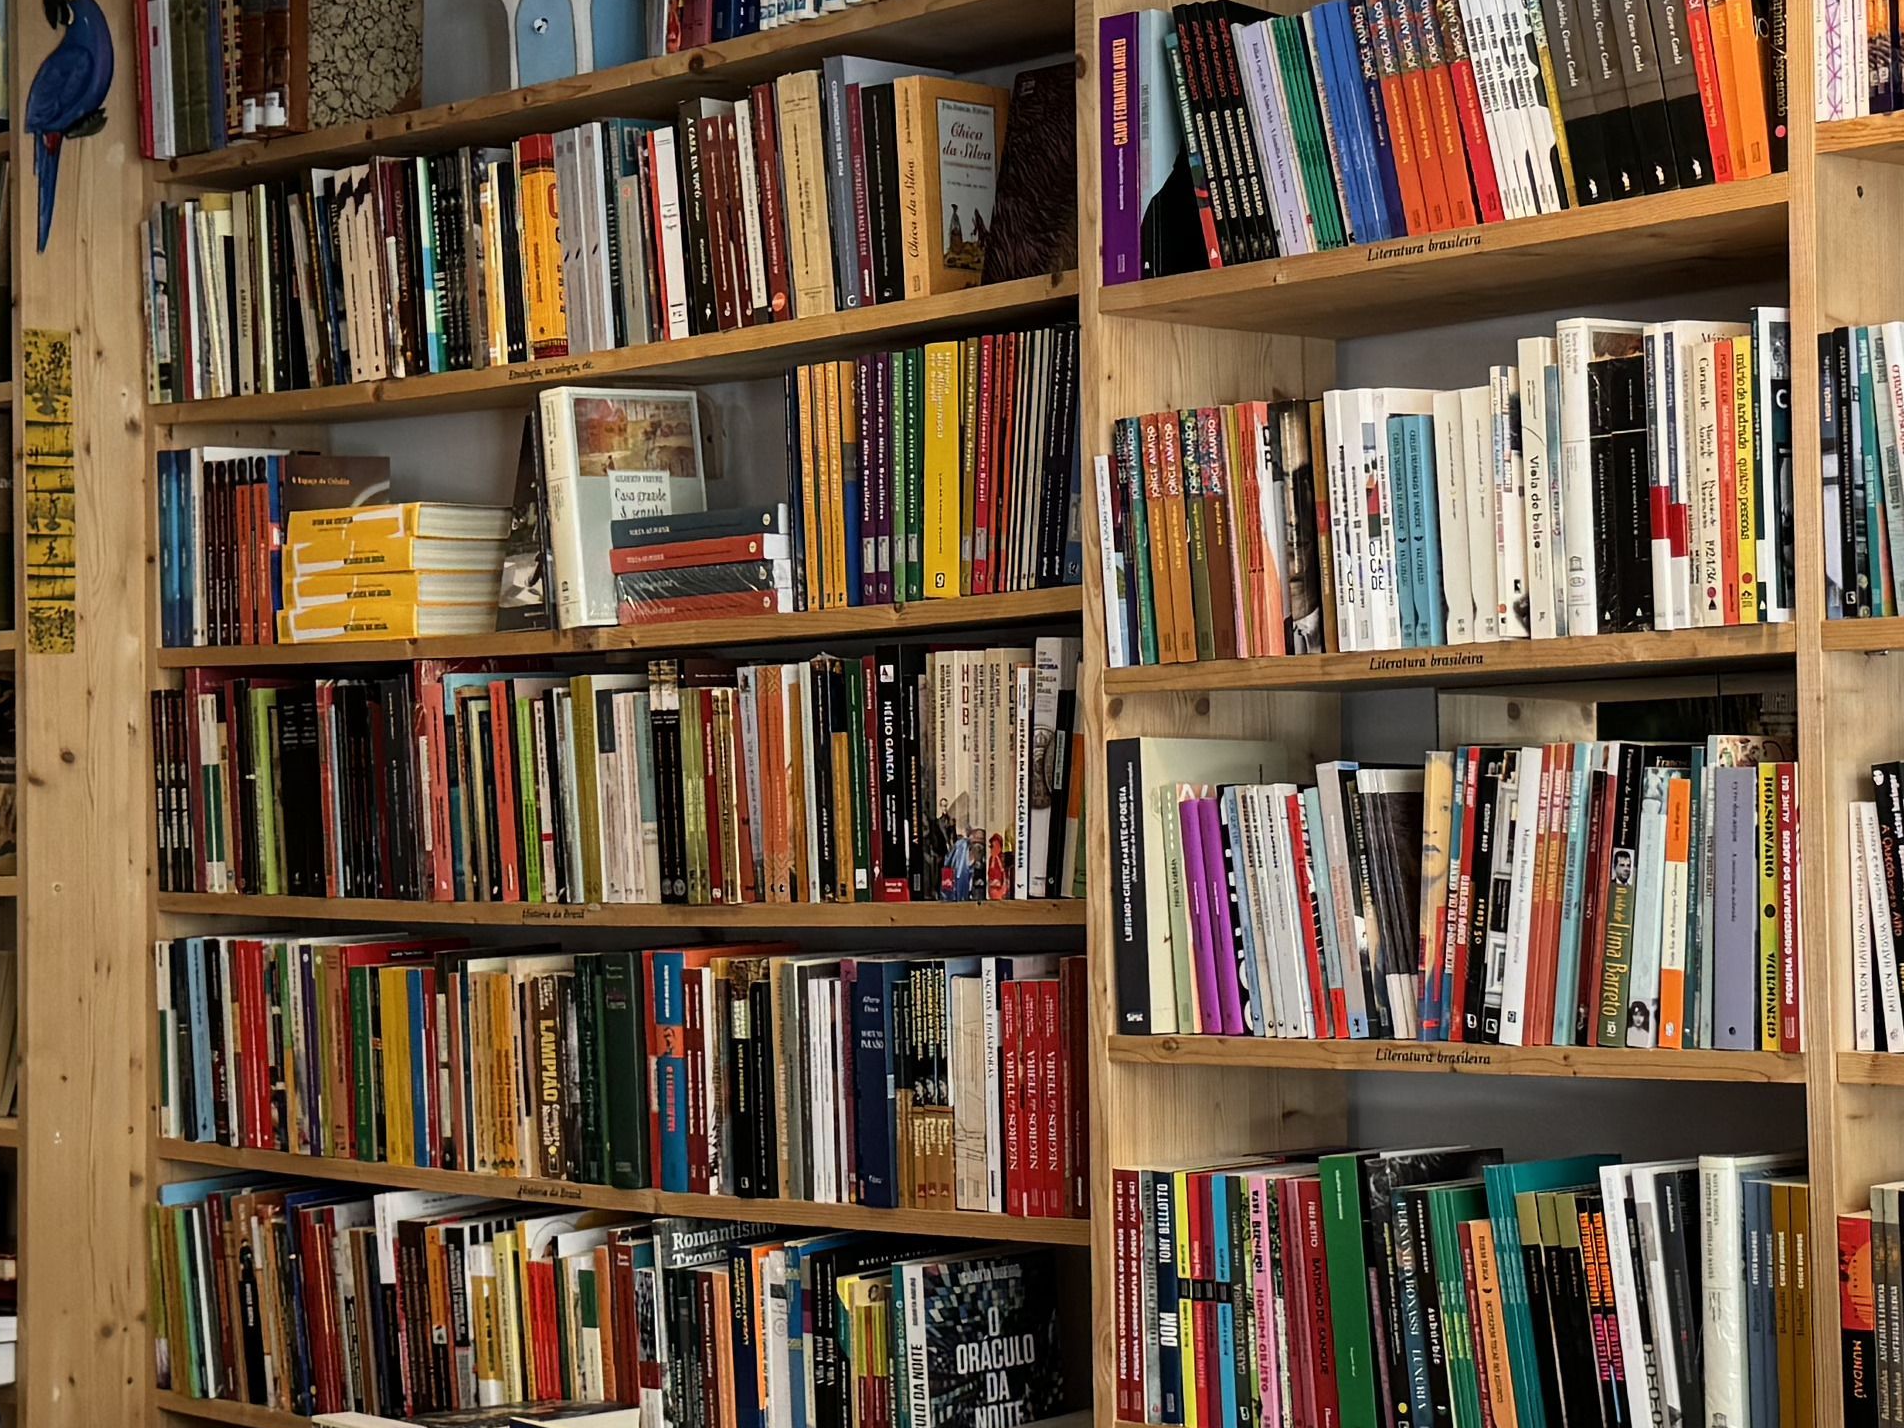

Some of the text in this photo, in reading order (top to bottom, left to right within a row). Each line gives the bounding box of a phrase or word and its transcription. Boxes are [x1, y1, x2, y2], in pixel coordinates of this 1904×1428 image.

[951, 122, 983, 141] Chica
[943, 140, 991, 161] da Silva
[1367, 233, 1482, 263] Literatura brasileira
[1369, 652, 1483, 672] Literatura brasileira
[1375, 1048, 1490, 1066] Literatura brasileira
[989, 1307, 999, 1336] O
[955, 1334, 1035, 1376] ORÁCULO
[986, 1376, 1011, 1402] DA
